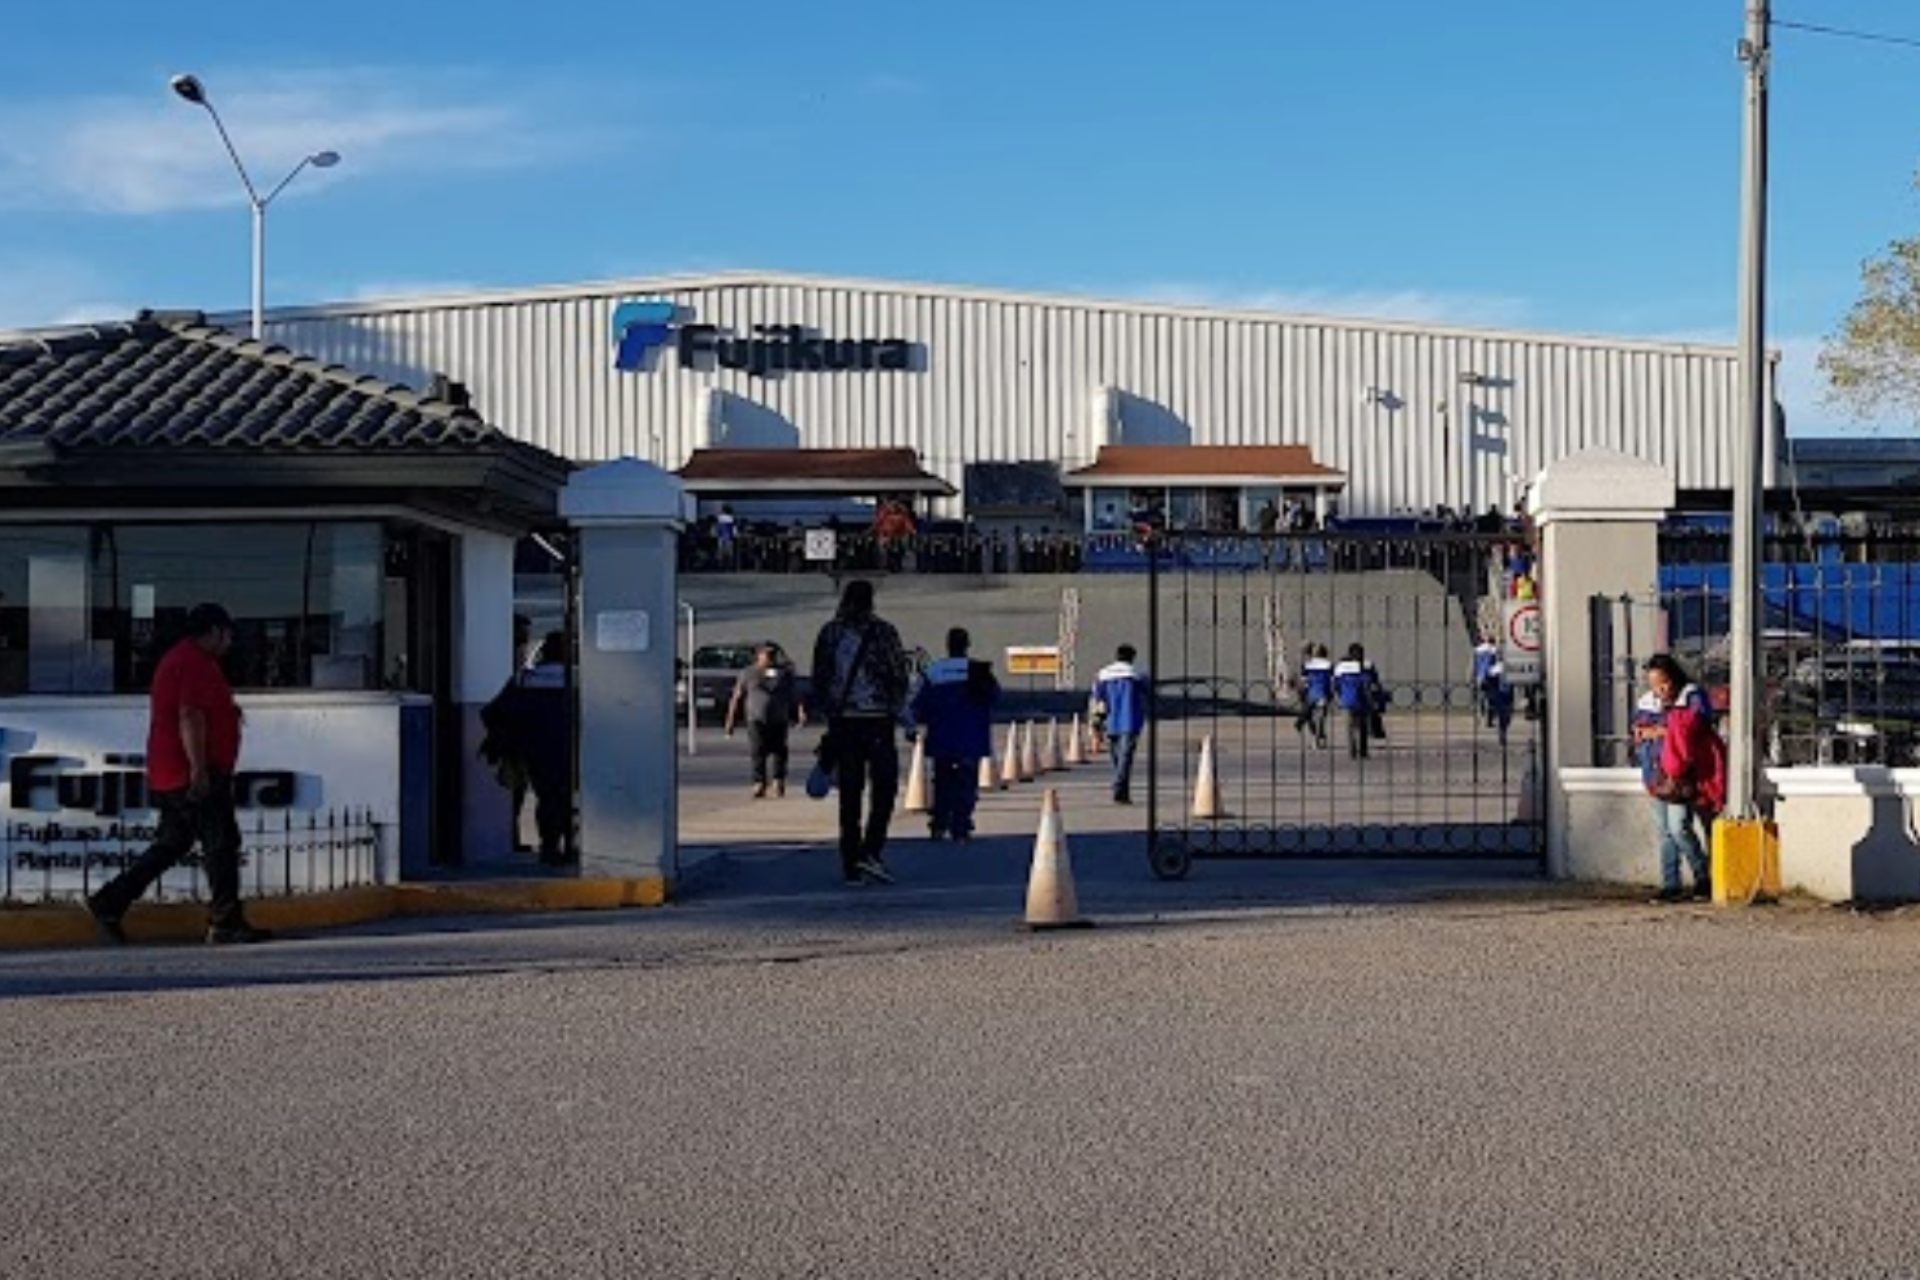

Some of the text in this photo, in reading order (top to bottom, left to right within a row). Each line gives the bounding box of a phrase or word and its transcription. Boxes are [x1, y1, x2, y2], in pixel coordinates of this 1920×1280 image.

[680, 324, 909, 376] Fujikura
[10, 753, 295, 817] Fujira
[17, 822, 100, 845] Fujikura
